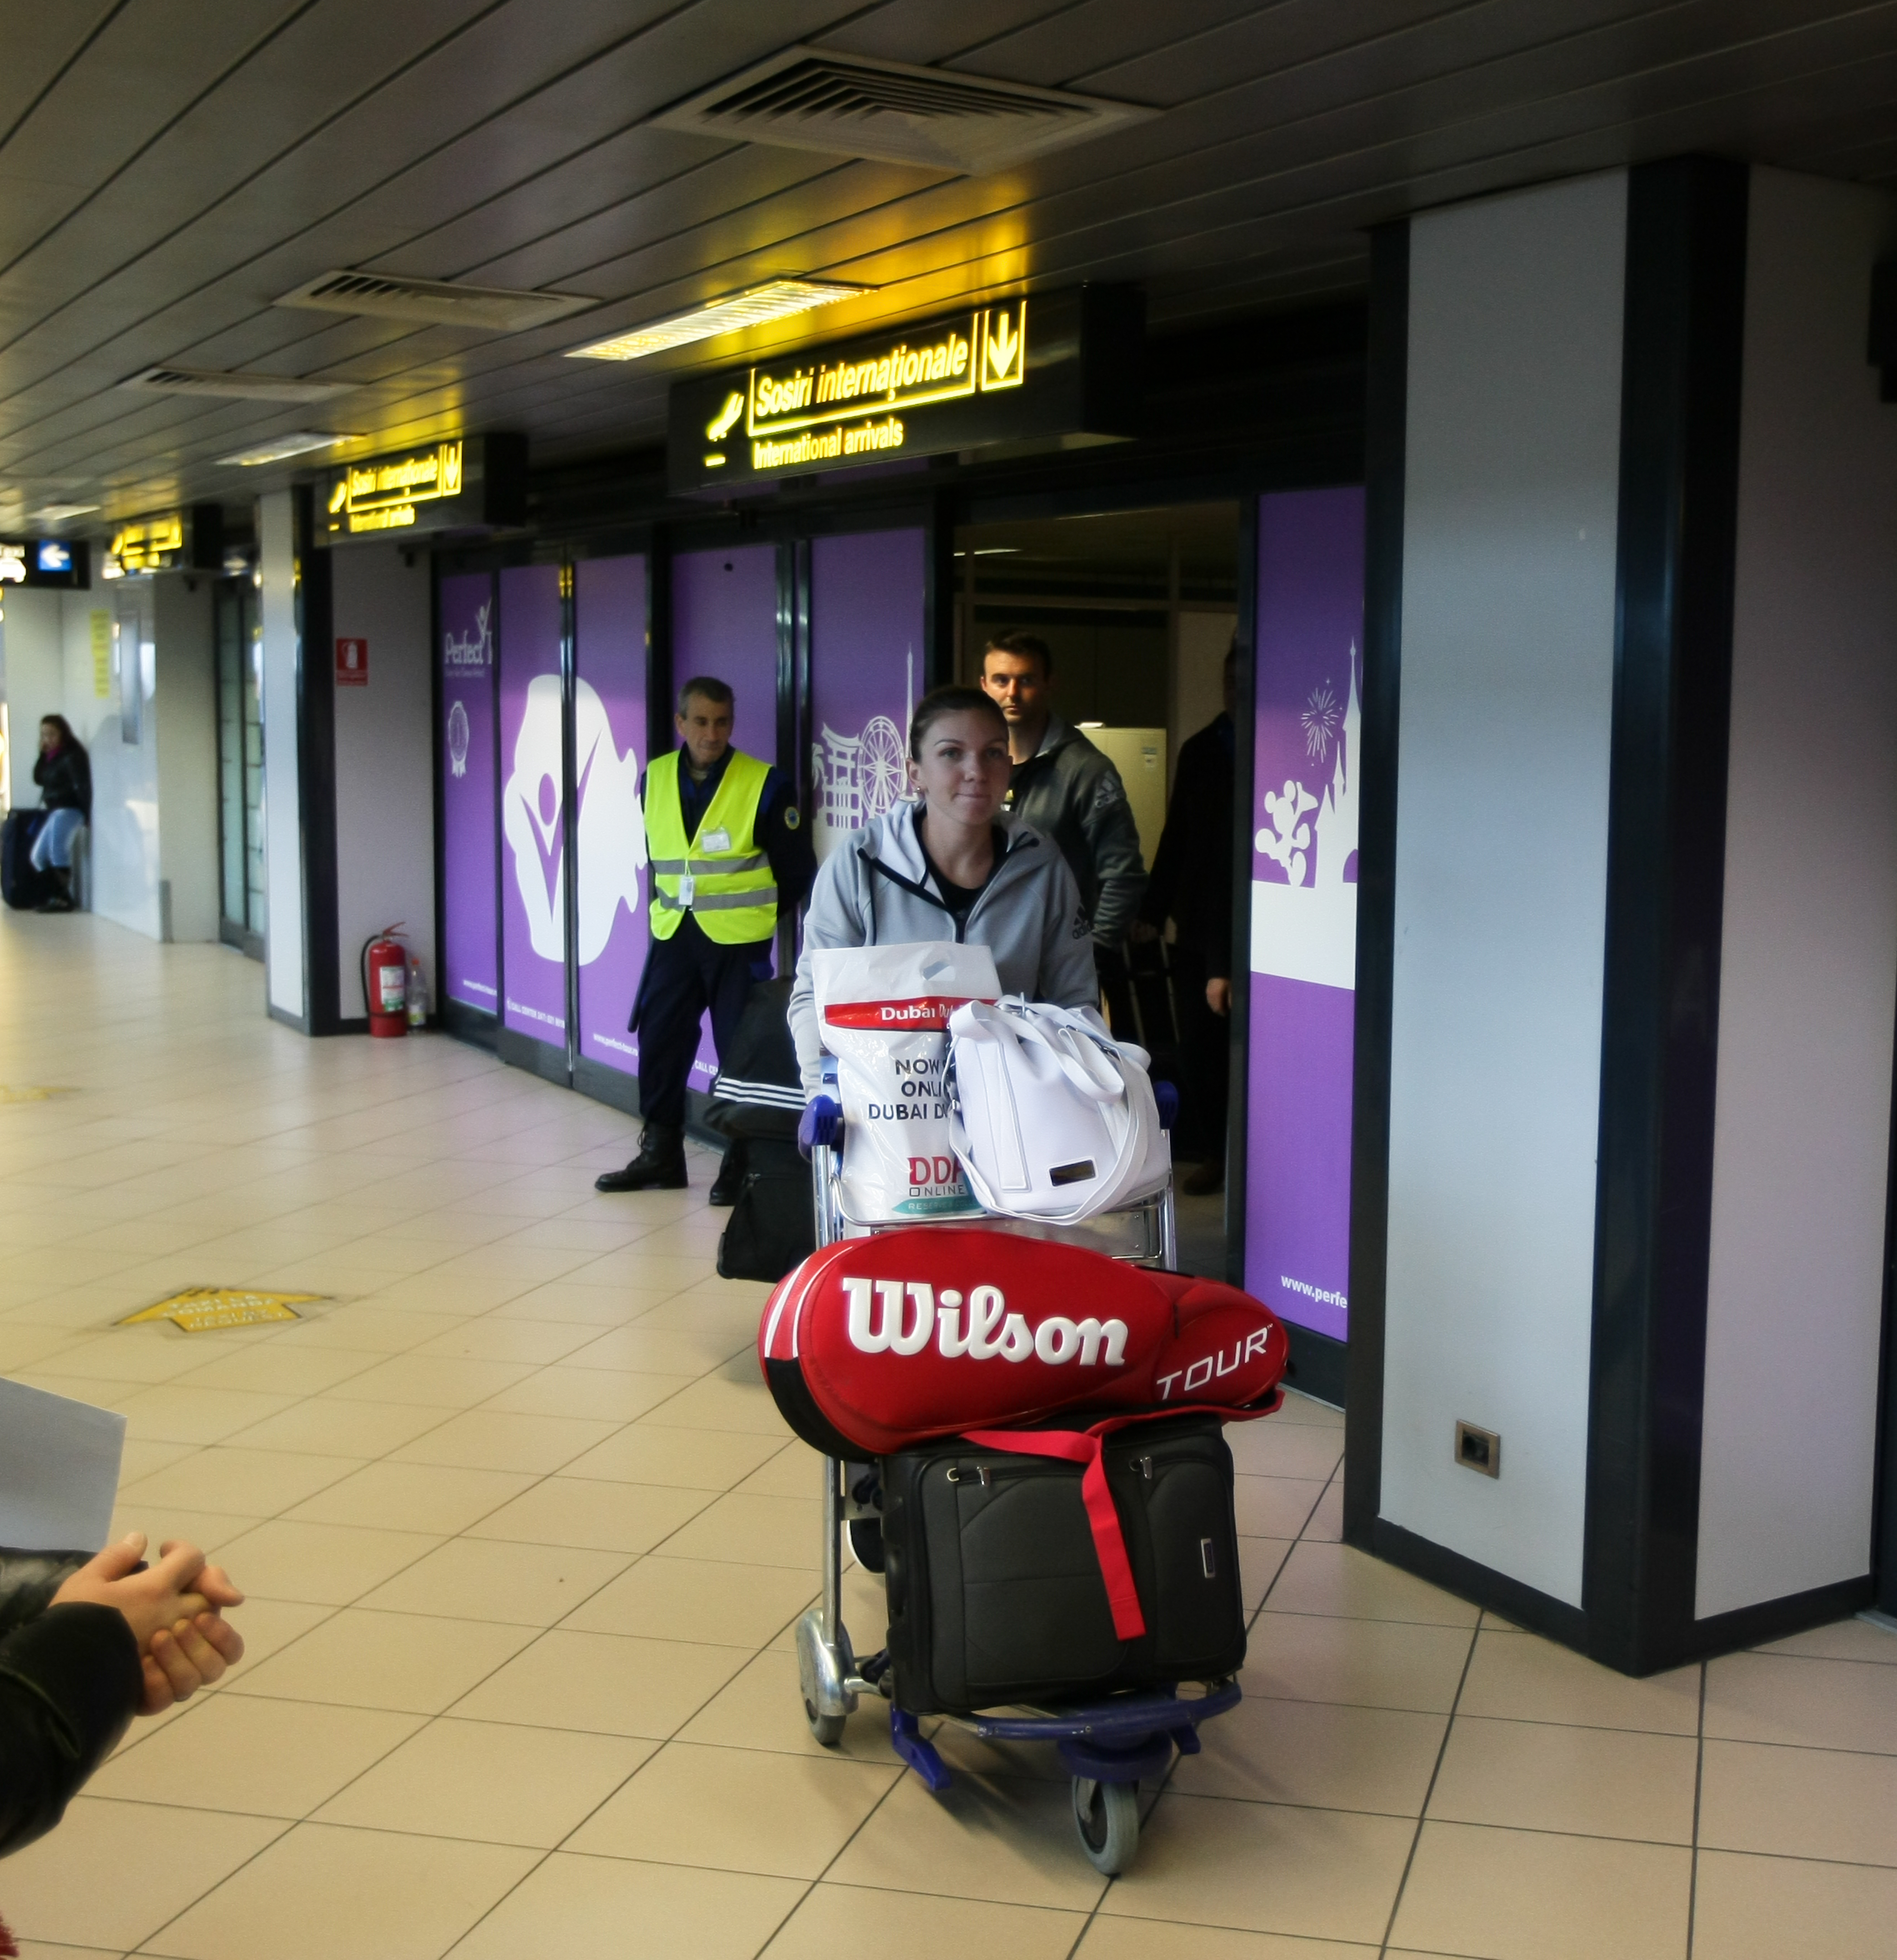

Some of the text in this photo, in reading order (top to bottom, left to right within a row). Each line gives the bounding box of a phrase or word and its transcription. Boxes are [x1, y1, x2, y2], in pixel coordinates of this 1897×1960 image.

[756, 367, 814, 417] Sosiri
[754, 417, 904, 469] International arrivals
[881, 1005, 935, 1021] Dubai
[895, 1058, 939, 1075] NOW
[868, 1103, 927, 1120] DUBAI
[909, 1185, 965, 1197] ONLINE
[843, 1277, 1129, 1367] Wilson
[1156, 1327, 1268, 1400] TOUR
